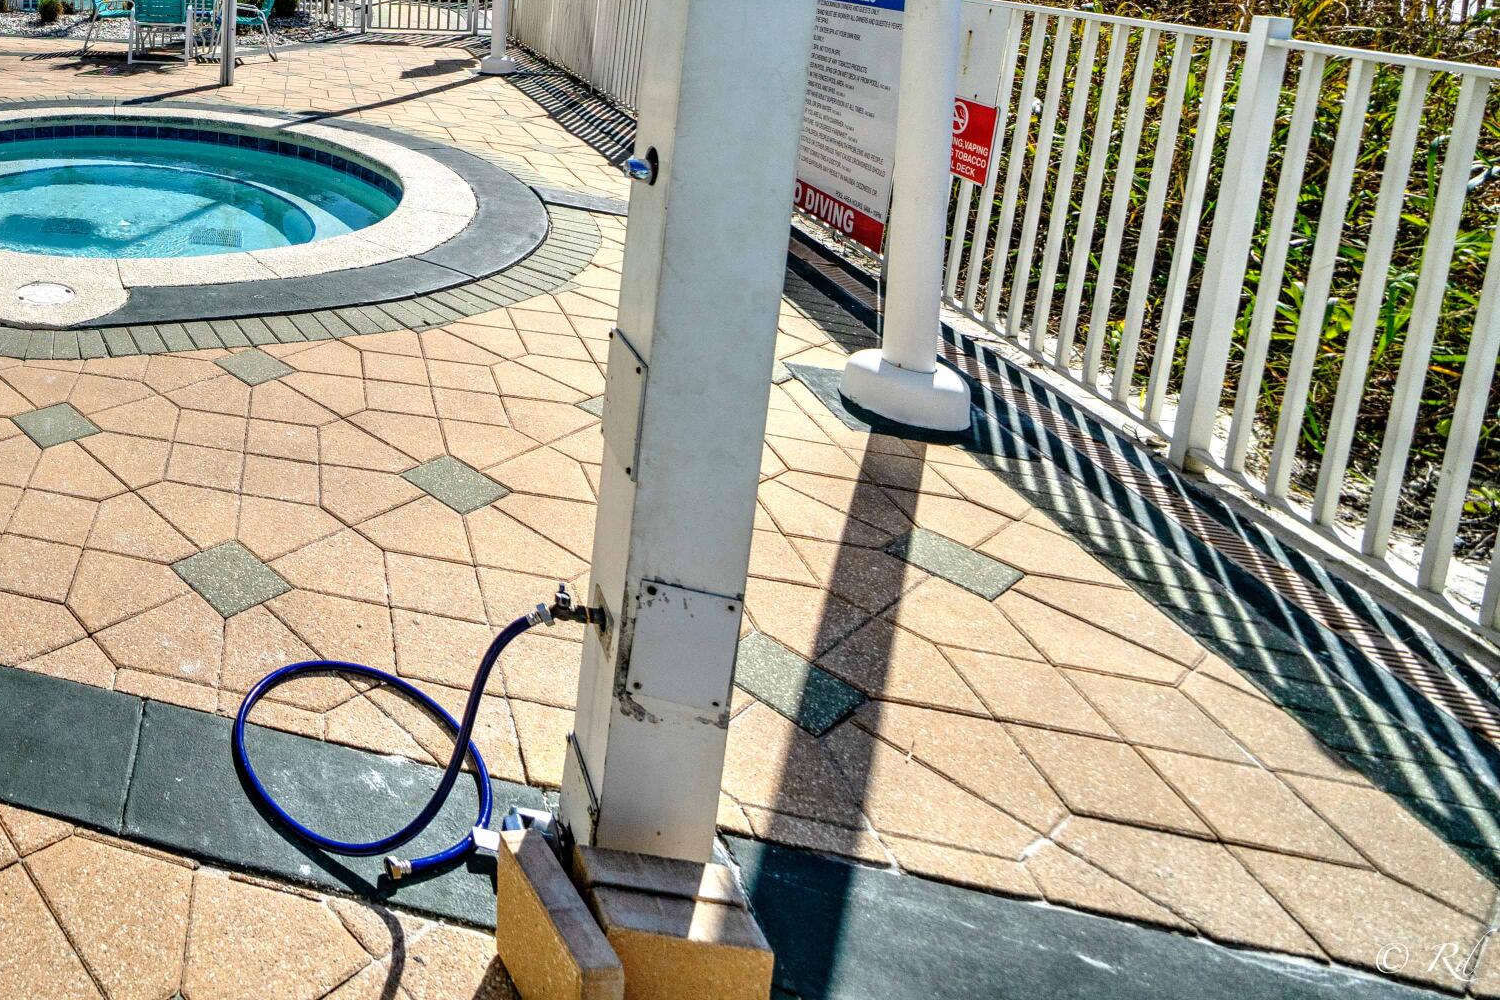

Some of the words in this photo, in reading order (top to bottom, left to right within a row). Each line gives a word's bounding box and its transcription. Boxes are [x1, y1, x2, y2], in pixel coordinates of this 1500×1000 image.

[955, 149, 987, 168] TOBACCO
[956, 162, 976, 177] DECK
[794, 181, 803, 203] O
[805, 187, 855, 233] DIVING
